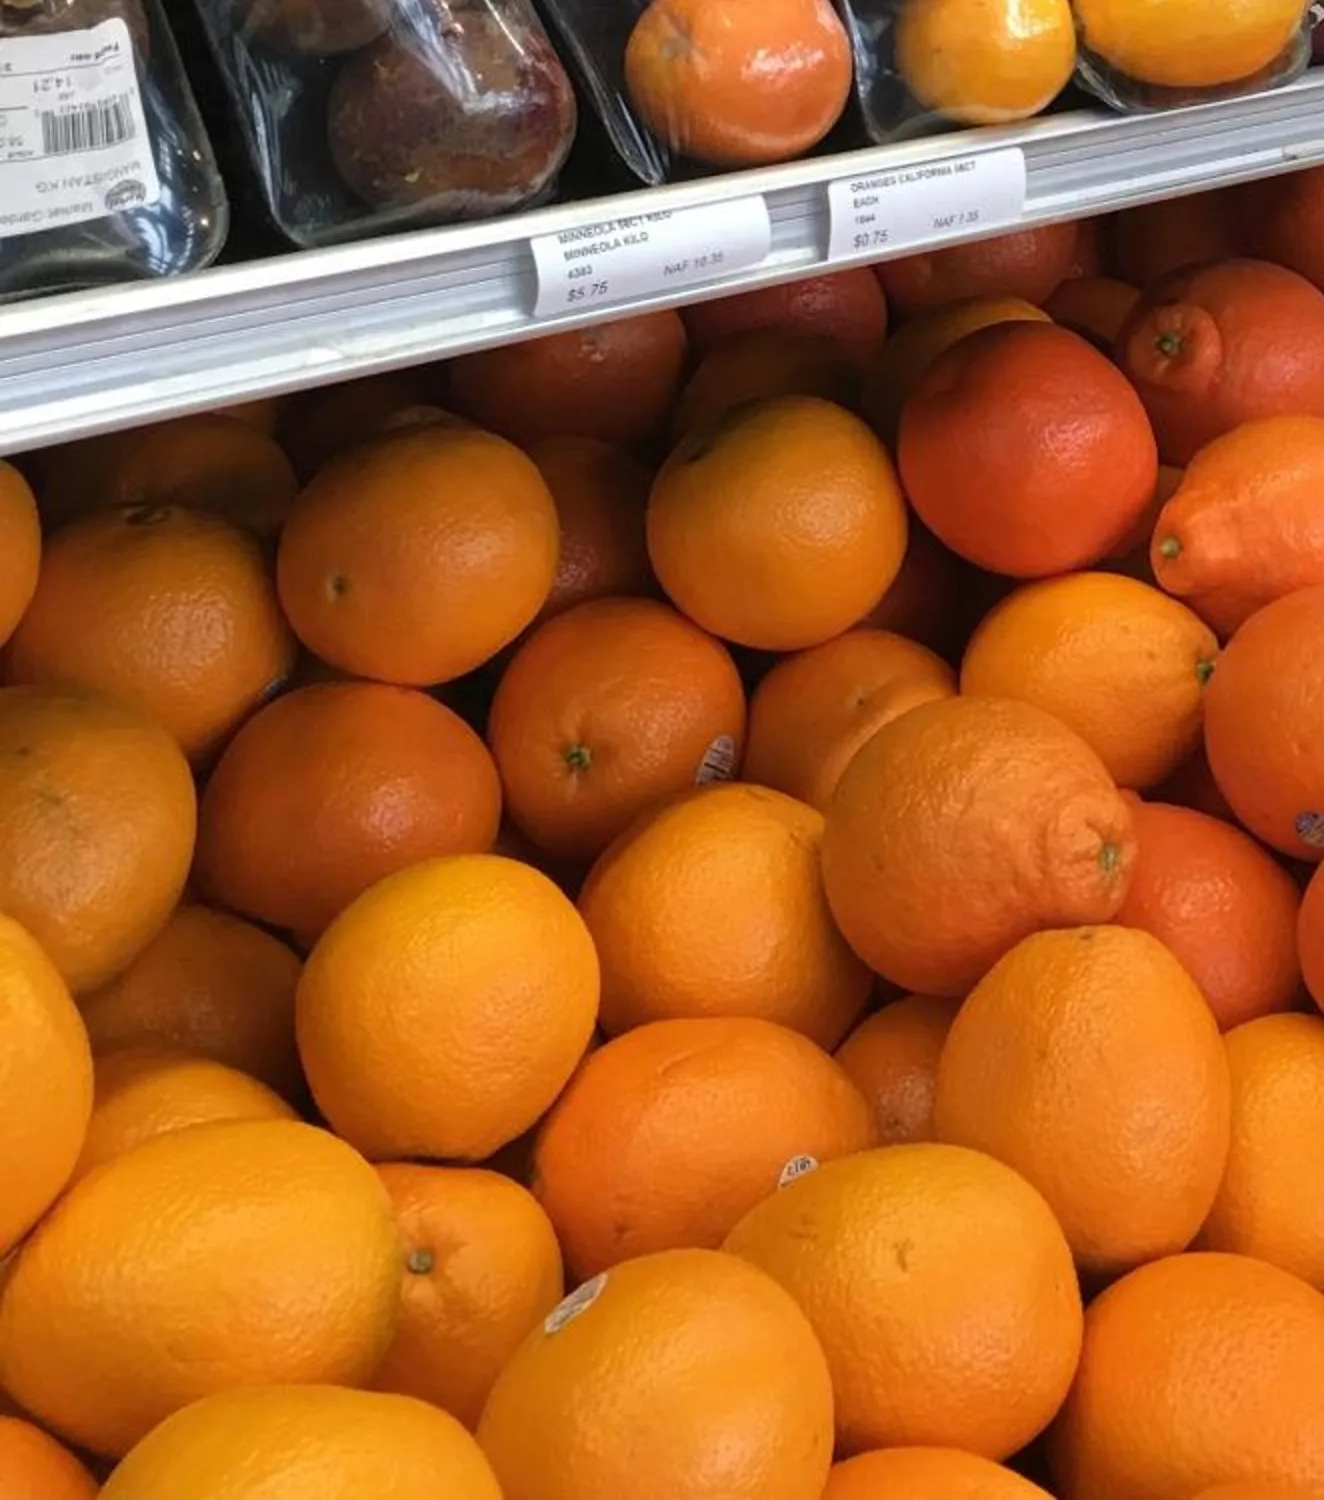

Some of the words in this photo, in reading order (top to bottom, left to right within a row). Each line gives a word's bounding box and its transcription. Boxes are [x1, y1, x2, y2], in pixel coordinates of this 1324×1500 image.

[899, 165, 952, 183] CALIFORNIA
[853, 196, 879, 209] EACH
[563, 240, 622, 261] MINNEOLA
[623, 231, 649, 245] KILO
[663, 260, 689, 277] NAF
